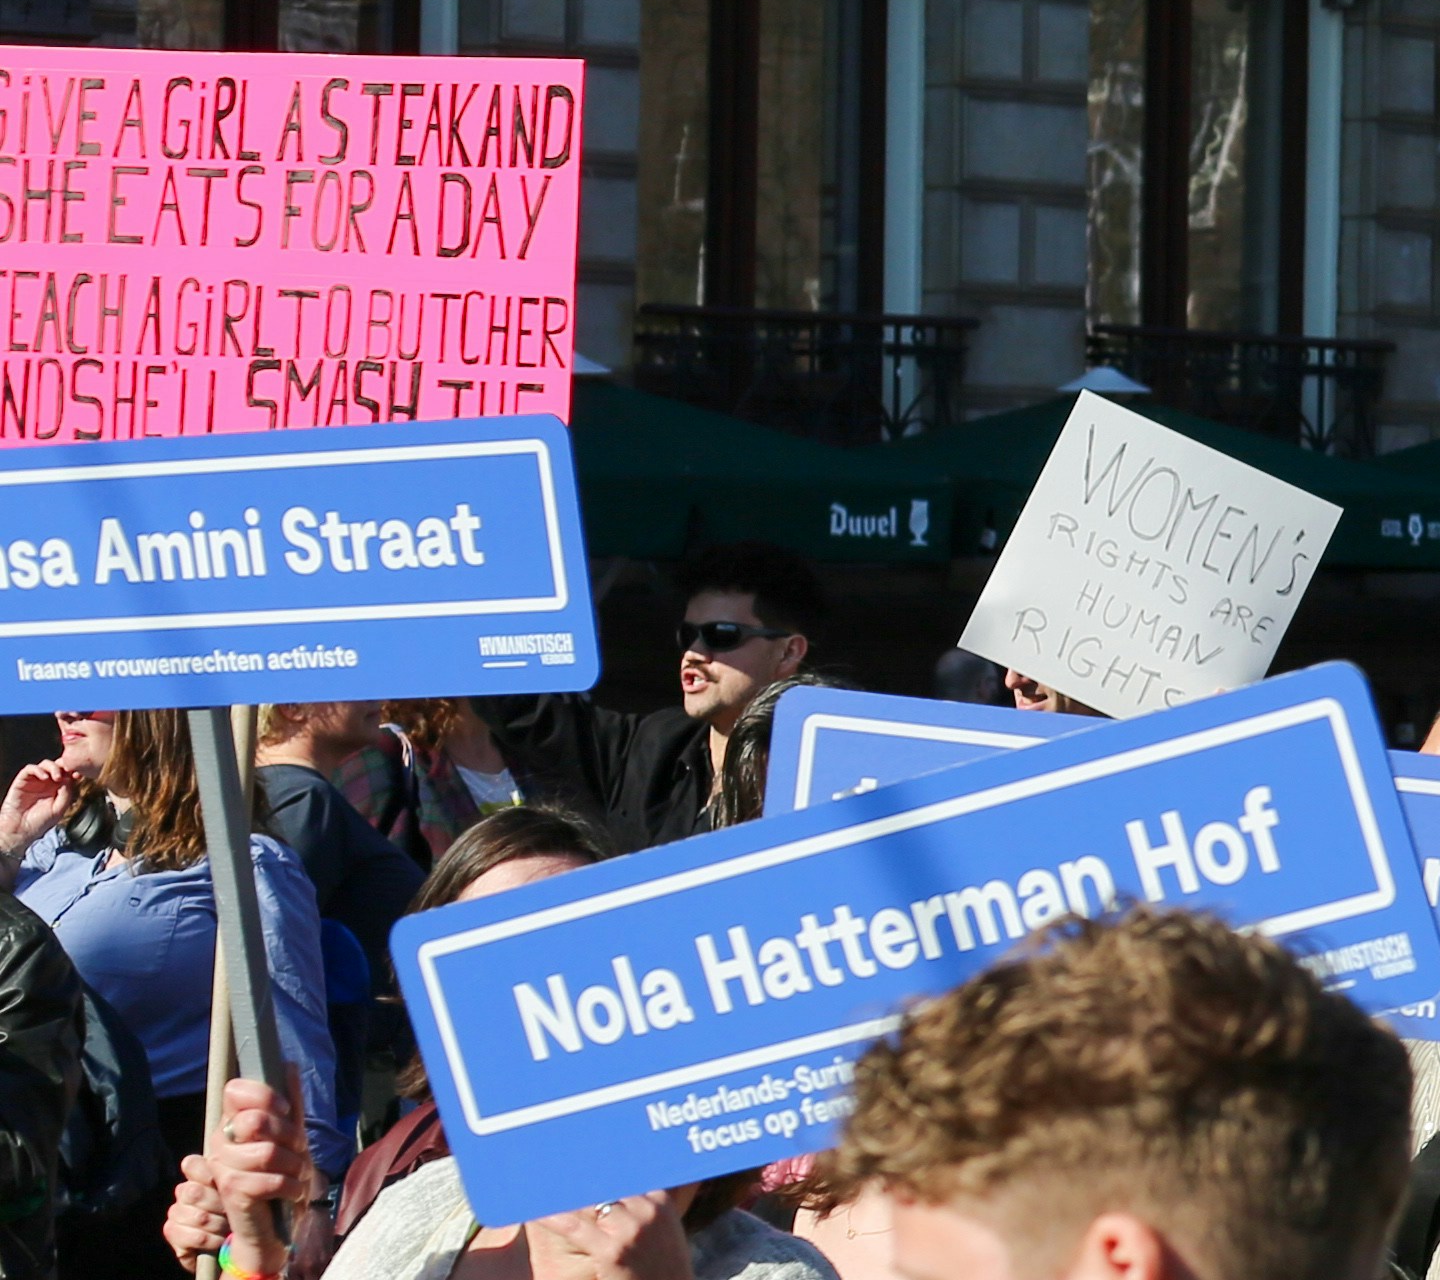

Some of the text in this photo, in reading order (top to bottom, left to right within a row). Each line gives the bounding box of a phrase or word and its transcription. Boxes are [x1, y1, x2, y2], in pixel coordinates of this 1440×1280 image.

[116, 79, 147, 160] A
[277, 81, 303, 164] A
[106, 165, 268, 249] EATS
[280, 169, 376, 254] FOR
[386, 171, 421, 258] A
[435, 171, 553, 261] DAY
[137, 275, 163, 358] A
[277, 283, 351, 362] TO
[365, 287, 569, 371] BUTCHER
[244, 357, 423, 430] SMASH
[0, 502, 486, 589] sa Amini Straat
[828, 503, 897, 538] Duvel
[1047, 511, 1277, 647] RIGHTS ARE
[17, 644, 358, 682] Iraanse vrouwenrechten activiste
[1076, 579, 1226, 667] HUMAN
[510, 784, 1283, 1062] Nola Hatterman Hof
[686, 1118, 763, 1154] focus
[764, 1108, 801, 1139] op
